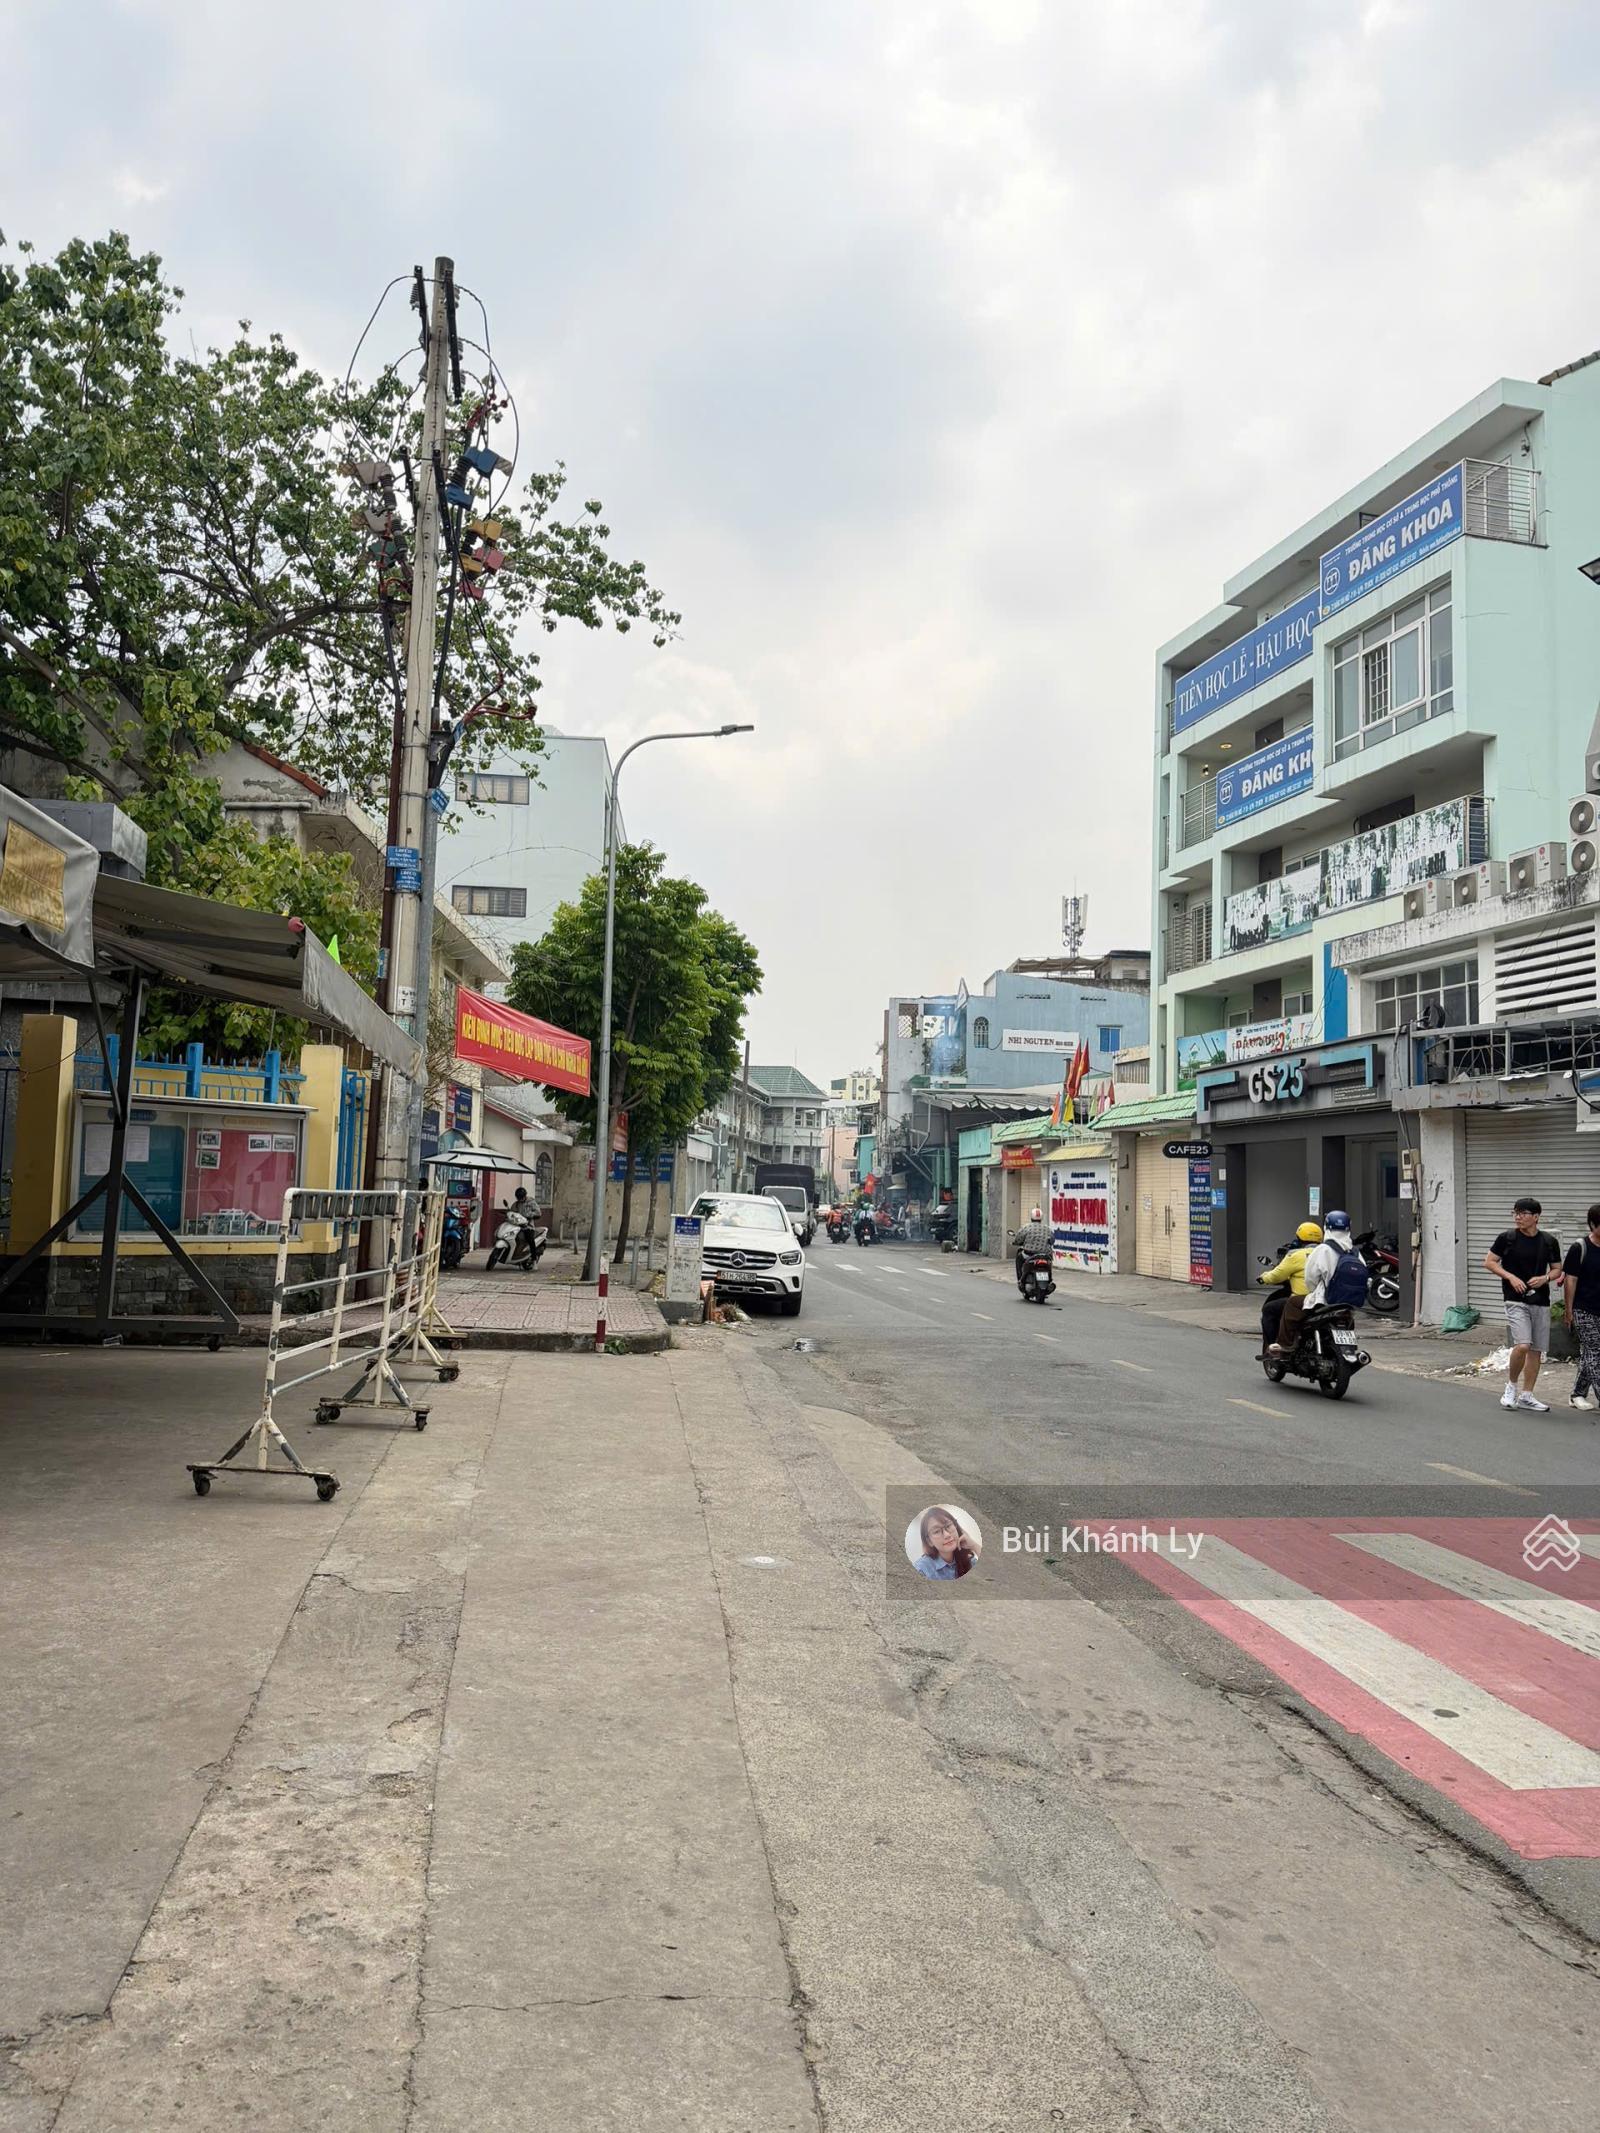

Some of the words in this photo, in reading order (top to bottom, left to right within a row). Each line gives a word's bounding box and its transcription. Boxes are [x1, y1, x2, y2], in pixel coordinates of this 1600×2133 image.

[1348, 535, 1396, 582] ĐĂNG
[1401, 498, 1454, 548] KHOA
[1178, 679, 1204, 716] TIÊN
[1205, 664, 1230, 700] HỌC
[1232, 647, 1248, 684] LỄ
[1255, 630, 1283, 669] HẬU
[1285, 610, 1315, 650] HỌC
[1241, 763, 1284, 798] ĐĂNG
[1288, 746, 1314, 777] KH
[1248, 1060, 1304, 1104] GS25
[1168, 1145, 1209, 1155] CAFE25
